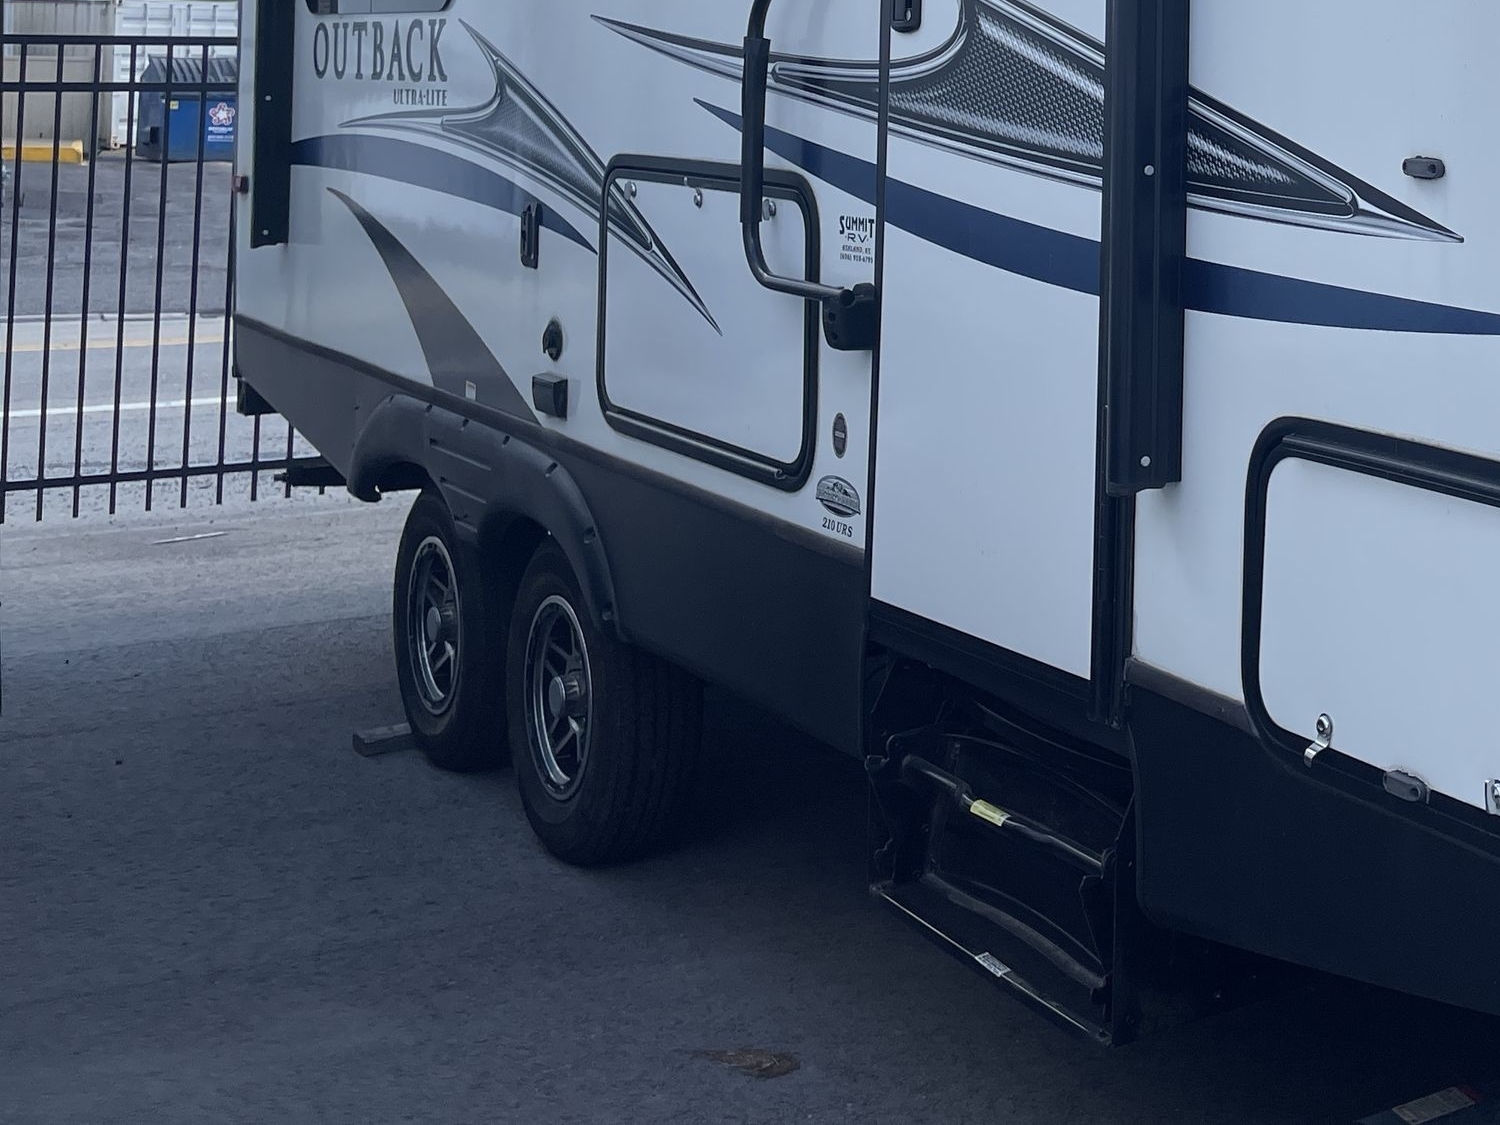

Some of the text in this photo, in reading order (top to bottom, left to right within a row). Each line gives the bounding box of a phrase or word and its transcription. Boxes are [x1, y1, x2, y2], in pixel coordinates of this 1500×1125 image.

[313, 18, 448, 83] OUTBACK
[839, 215, 875, 239] SUMMIT
[847, 232, 868, 244] RV
